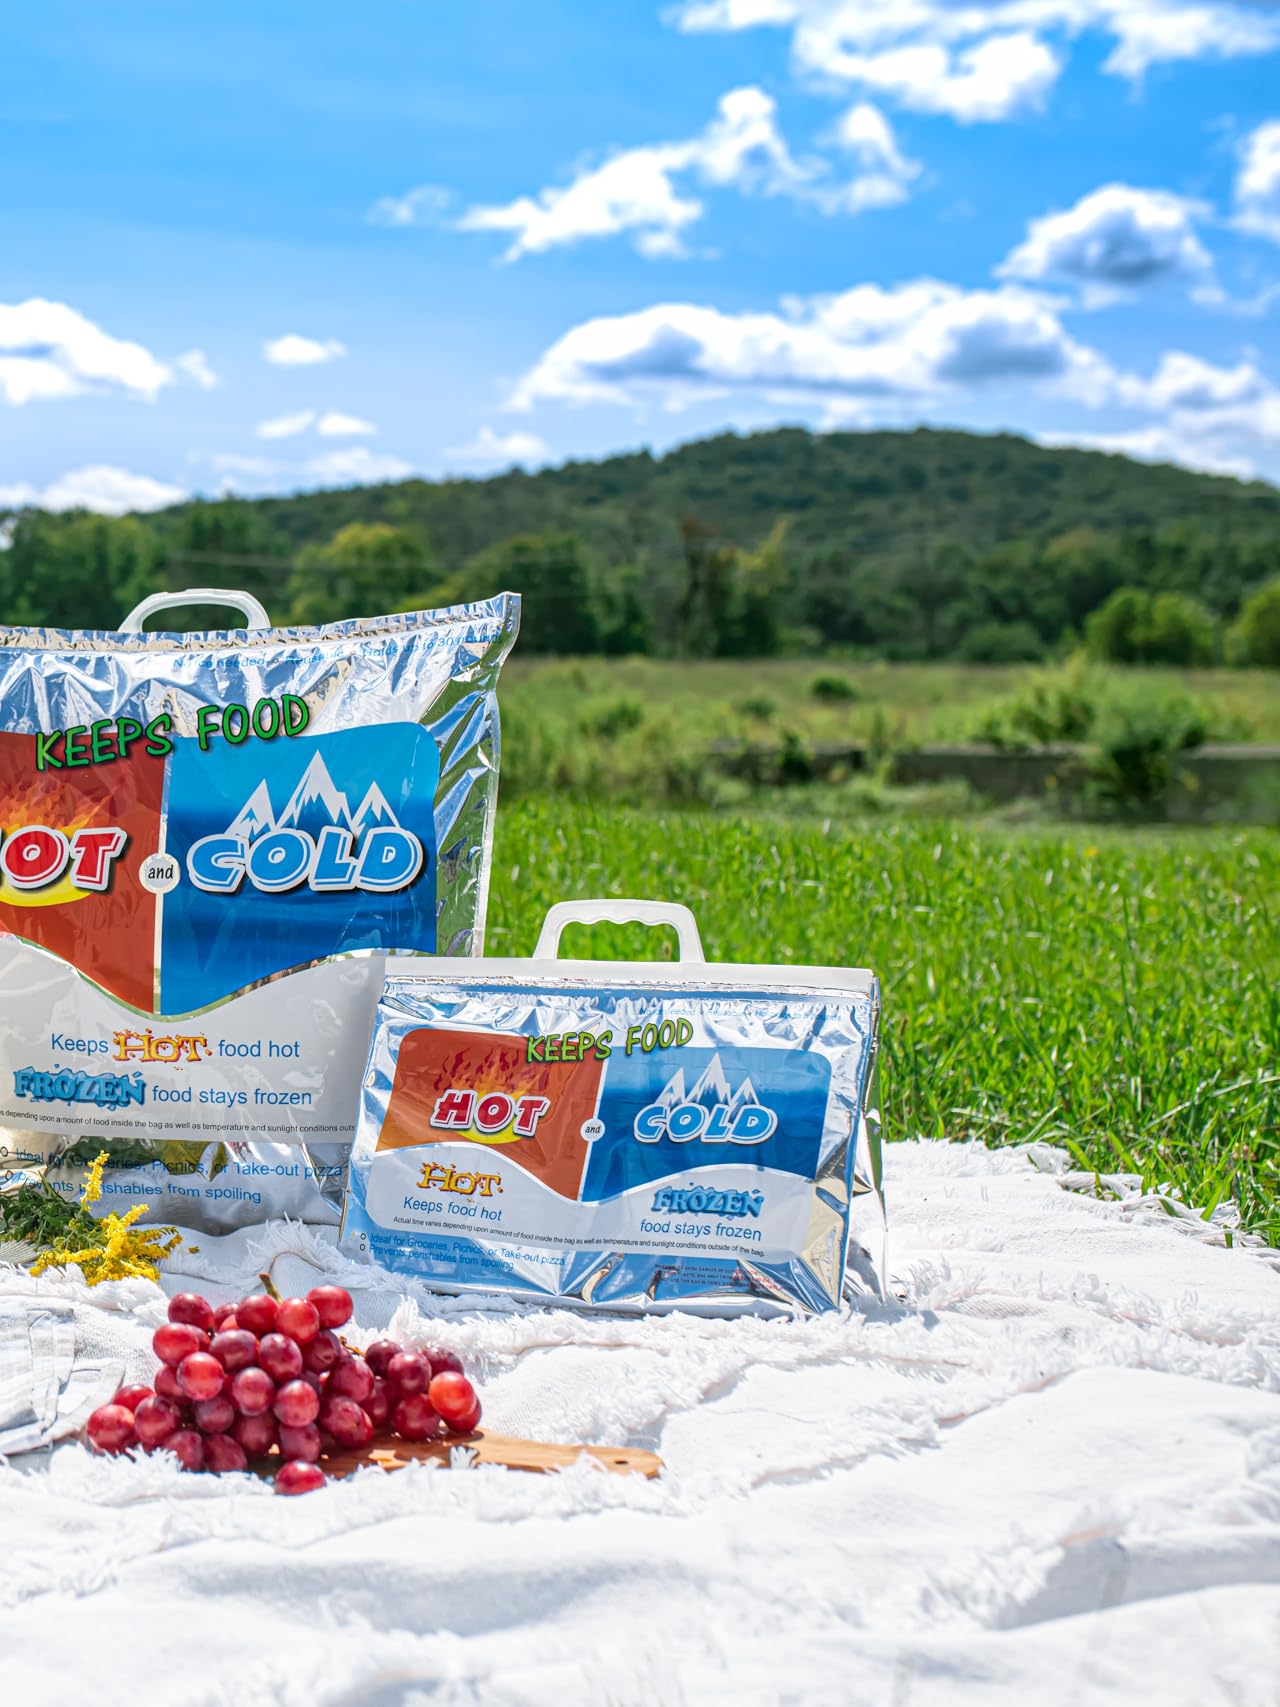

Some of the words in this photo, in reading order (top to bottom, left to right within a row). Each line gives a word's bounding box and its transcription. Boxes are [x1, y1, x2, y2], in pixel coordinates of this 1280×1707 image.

[217, 656, 265, 668] needed
[423, 641, 434, 650] to
[438, 637, 454, 647] 30
[36, 713, 173, 771] KEEPS
[197, 693, 310, 751] FOOD
[148, 864, 174, 882] and
[187, 825, 424, 893] COLD
[51, 1033, 109, 1056] Keeps
[112, 1029, 209, 1063] HOT
[218, 1039, 261, 1057] food
[268, 1040, 300, 1058] hot
[526, 1029, 612, 1064] KEEPS
[624, 1018, 693, 1057] FOOD
[13, 1066, 146, 1108] FROZEN
[152, 1085, 192, 1103] food
[199, 1088, 248, 1108] stays
[254, 1088, 313, 1106] frozen
[6, 1110, 38, 1122] depending
[39, 1114, 55, 1122] upon
[56, 1116, 83, 1125] amount
[84, 1117, 92, 1126] of
[93, 1117, 110, 1126] food
[111, 1118, 134, 1127] inside
[134, 1120, 146, 1128] the
[148, 1121, 163, 1130] bag
[202, 1123, 250, 1132] temperature
[251, 1124, 266, 1132] and
[268, 1124, 298, 1134] sunlight
[299, 1124, 338, 1133] conditions
[339, 1124, 355, 1132] outs
[430, 1089, 551, 1137] HOT
[585, 1125, 601, 1135] and
[634, 1102, 778, 1144] COLD
[16, 1147, 44, 1164] Ideal
[152, 1160, 209, 1176] Picnics,
[215, 1163, 229, 1174] or
[235, 1163, 299, 1177] Take-out
[305, 1164, 342, 1180] pizza
[416, 1162, 503, 1197] HOT
[168, 1184, 200, 1198] from
[205, 1187, 261, 1204] spoiling
[403, 1196, 443, 1214] Keeps
[448, 1201, 477, 1217] food
[480, 1207, 502, 1221] hot
[651, 1185, 765, 1219] FROZEN
[394, 1216, 412, 1224] Actual
[412, 1218, 424, 1226] time
[425, 1220, 442, 1228] varies
[442, 1221, 472, 1233] depending
[474, 1226, 489, 1234] upon
[490, 1228, 512, 1237] amount
[513, 1230, 520, 1238] of
[520, 1231, 534, 1240] food
[534, 1233, 553, 1242] inside
[554, 1235, 563, 1243] the
[564, 1236, 575, 1246] bag
[602, 1238, 638, 1248] temperature
[652, 1240, 675, 1249] sunlight
[676, 1240, 707, 1250] conditions
[708, 1242, 731, 1252] outside
[732, 1244, 739, 1252] of
[740, 1246, 750, 1254] the
[751, 1248, 765, 1258] bag.
[640, 1218, 670, 1233] food
[674, 1221, 711, 1238] stays
[716, 1223, 762, 1241] frozen
[370, 1232, 392, 1244] Ideal
[393, 1235, 405, 1245] for
[407, 1237, 450, 1252] Groceries,
[488, 1248, 498, 1256] or
[500, 1247, 539, 1262] Take-out
[541, 1256, 565, 1266] pizza
[370, 1243, 406, 1257] Prevents
[408, 1250, 457, 1263] perishables
[460, 1254, 478, 1265] from
[481, 1257, 514, 1270] spoiling
